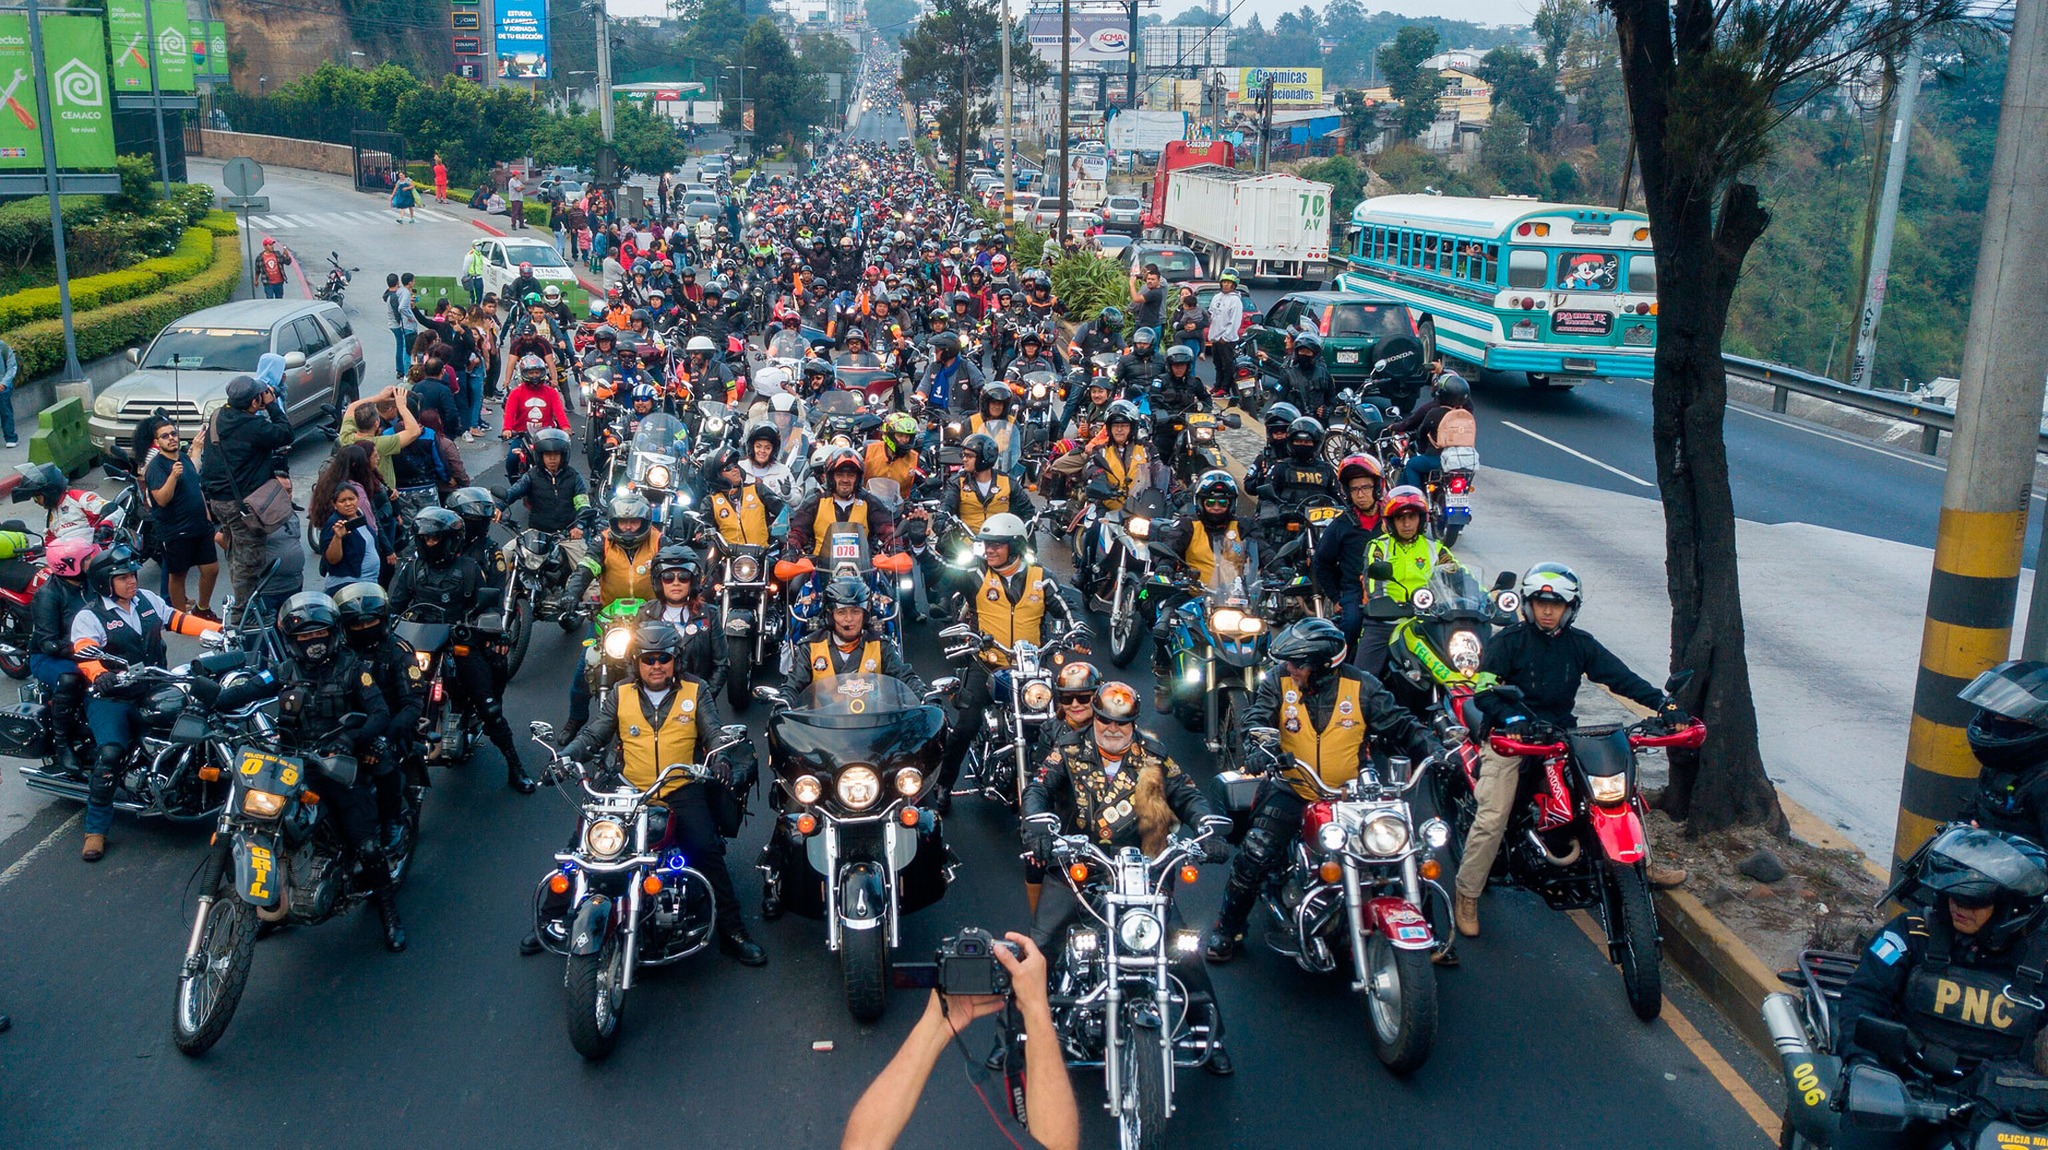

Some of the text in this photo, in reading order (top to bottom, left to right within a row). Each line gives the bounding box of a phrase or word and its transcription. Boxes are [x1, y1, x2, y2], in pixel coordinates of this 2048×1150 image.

[1099, 33, 1124, 41] ACMA
[61, 111, 102, 120] CEMACO
[1299, 194, 1325, 217] 70
[1304, 219, 1321, 231] AV
[1557, 311, 1607, 325] PAQUETE
[1296, 471, 1323, 485] PNC
[836, 545, 856, 557] 078
[1432, 661, 1450, 680] 123
[249, 846, 272, 899] GRIL
[1933, 978, 2015, 1029] PNC
[1793, 1063, 1826, 1107] 006
[1013, 1086, 1028, 1131] anon
